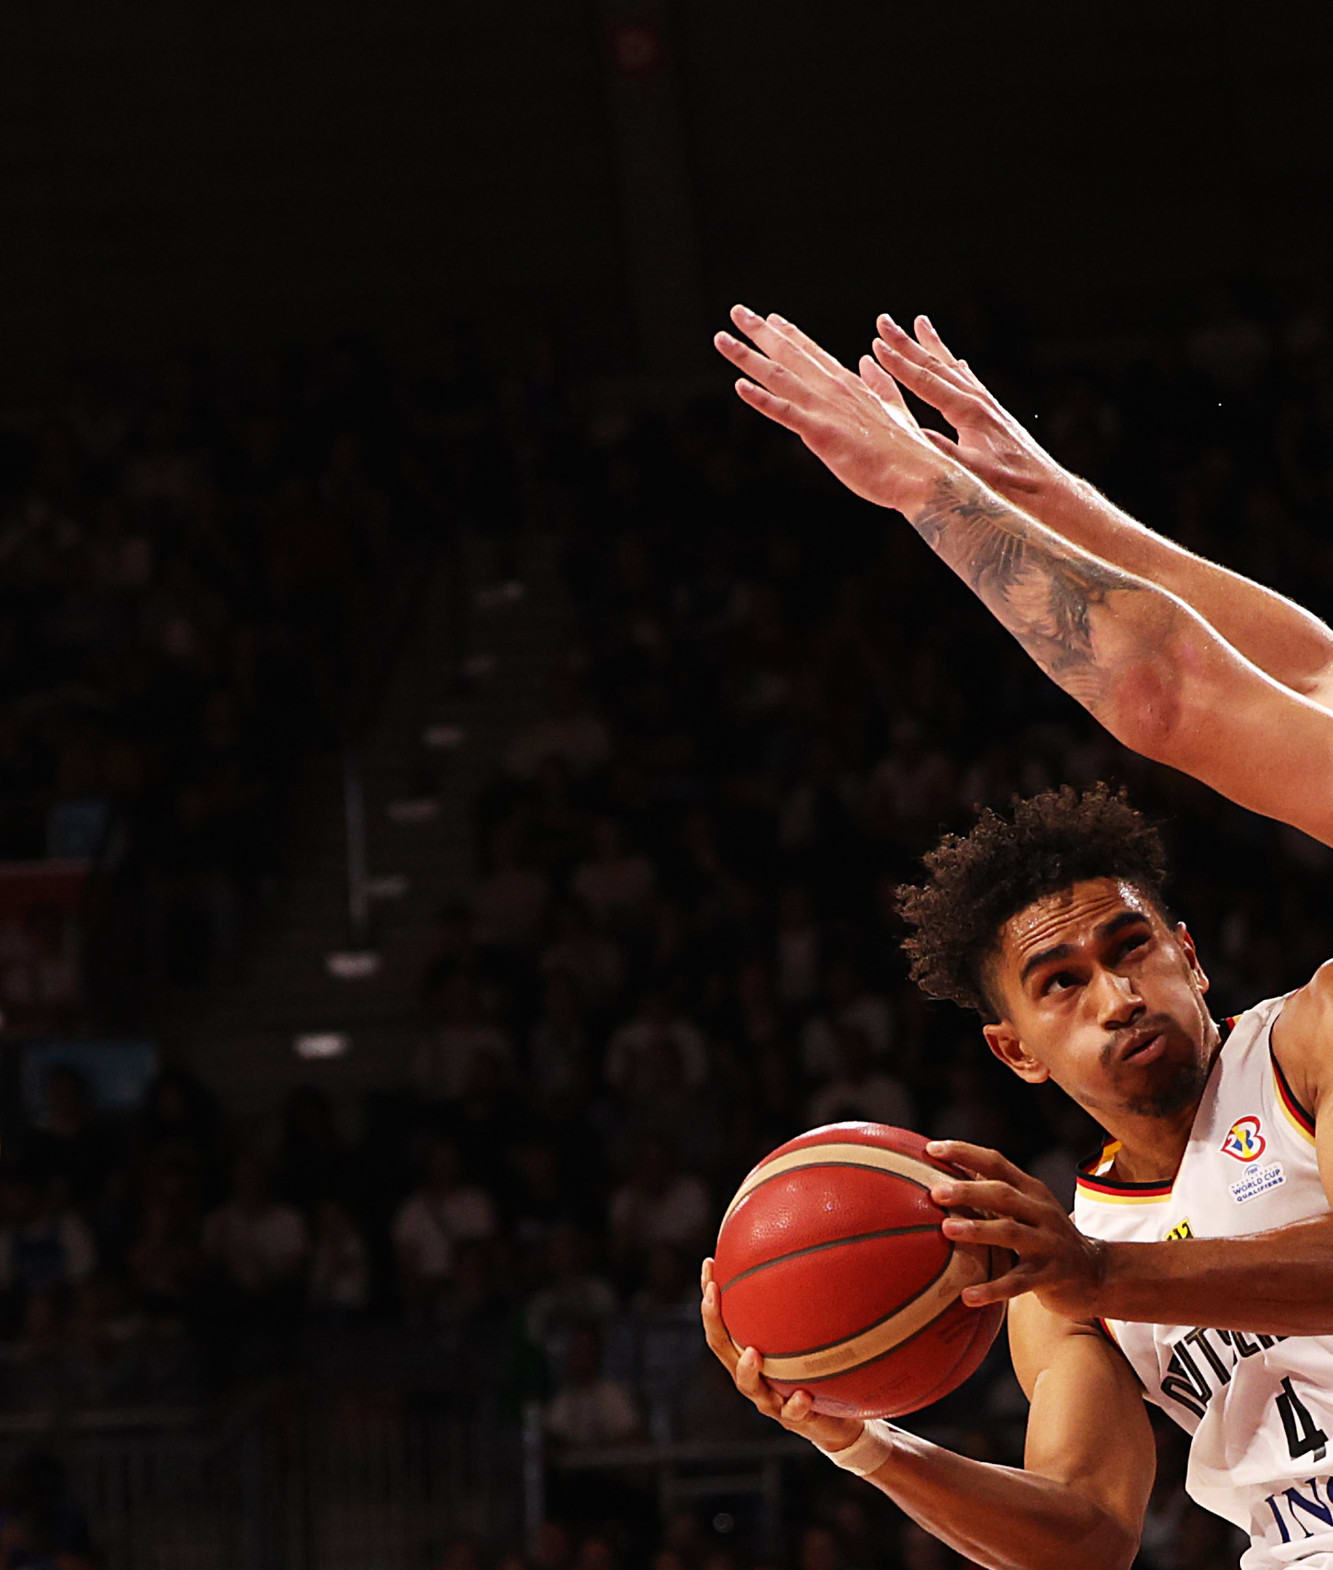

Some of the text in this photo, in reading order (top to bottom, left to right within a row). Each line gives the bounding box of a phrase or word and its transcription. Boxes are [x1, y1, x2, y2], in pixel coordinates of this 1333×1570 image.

[1233, 1168, 1281, 1195] WORLD CUP
[1236, 1177, 1284, 1202] QUALIFIERS
[1275, 1376, 1328, 1463] 4
